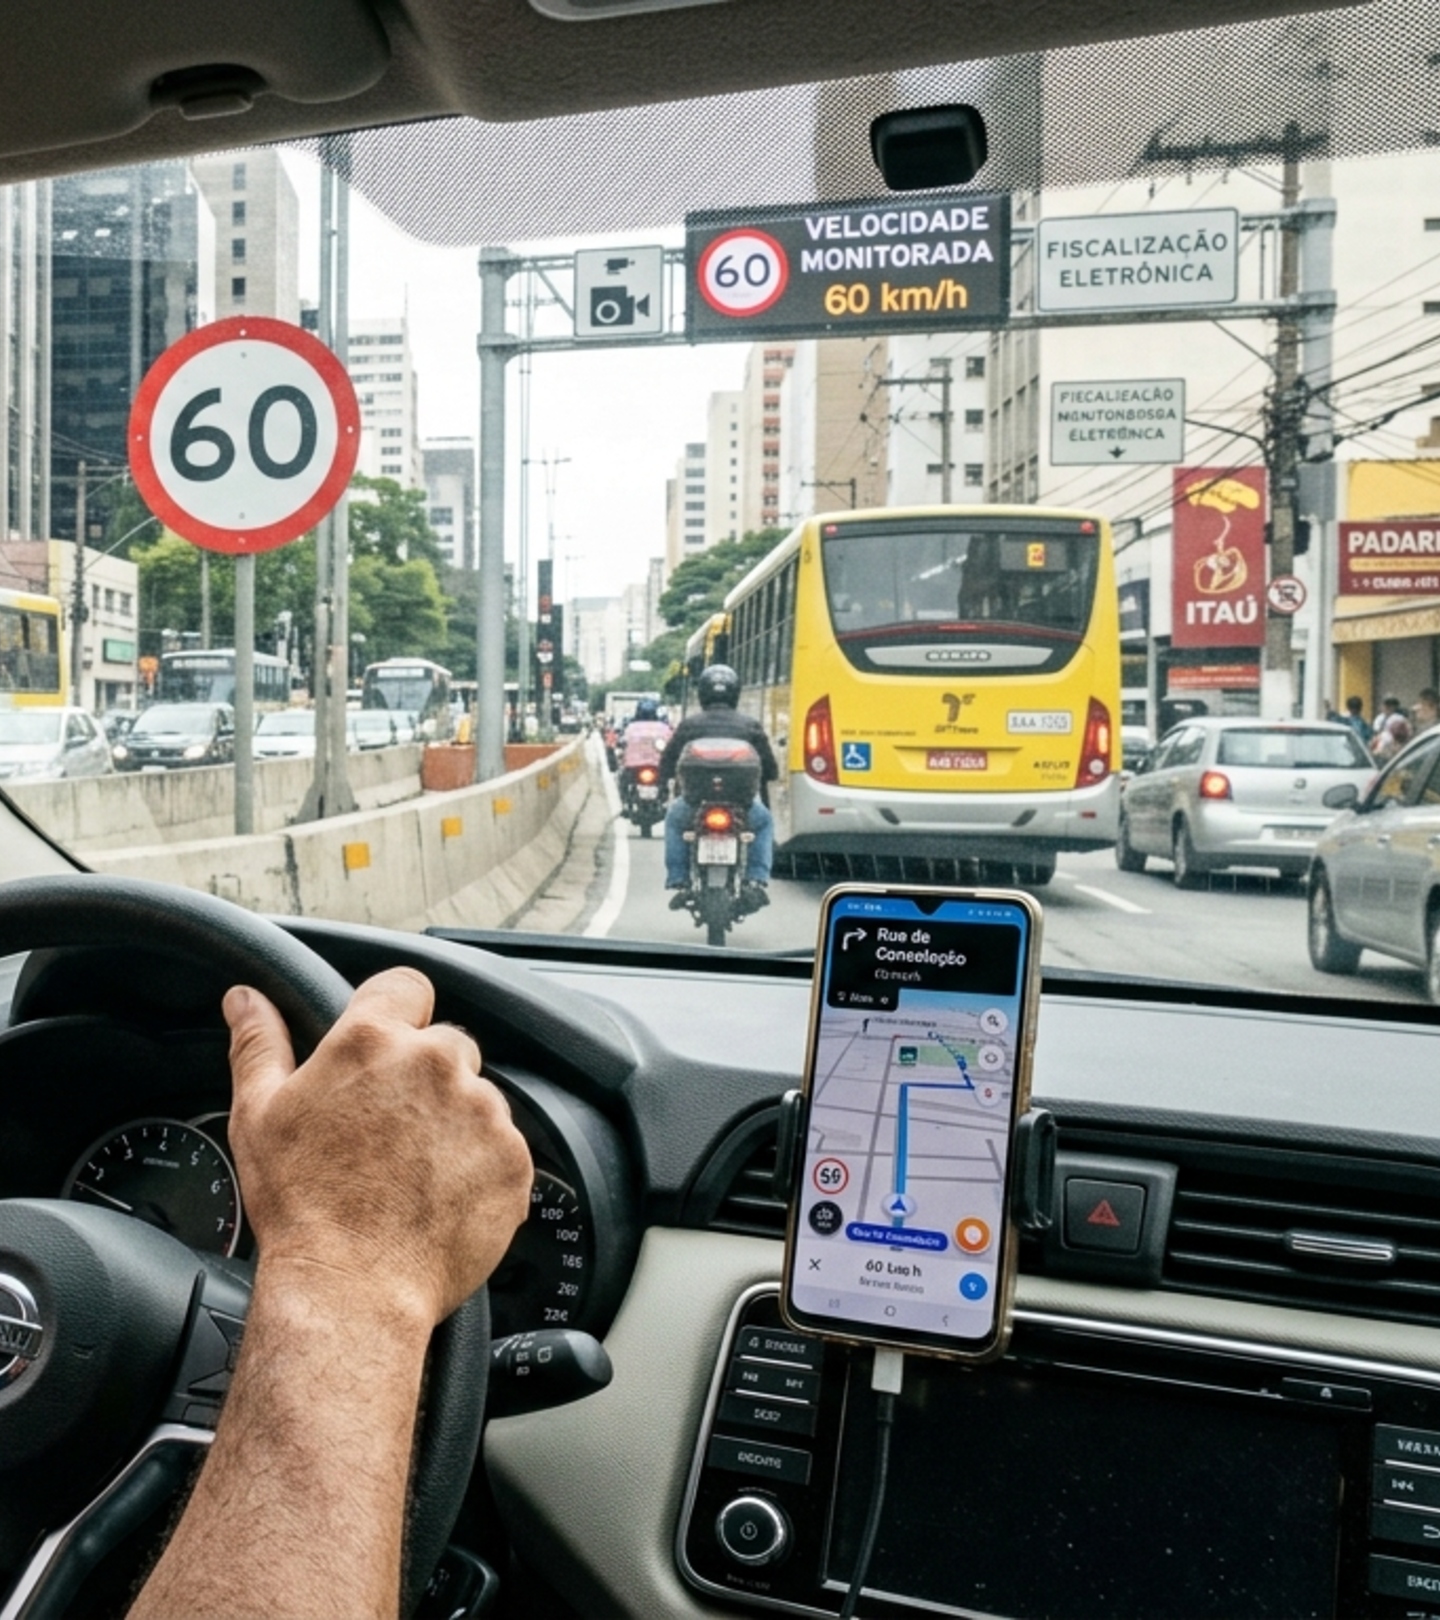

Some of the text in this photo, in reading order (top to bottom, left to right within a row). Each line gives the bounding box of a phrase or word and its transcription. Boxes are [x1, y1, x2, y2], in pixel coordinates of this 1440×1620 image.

[804, 206, 990, 241] VELOCIDADE
[800, 239, 994, 273] MONITORADA
[1047, 227, 1228, 260] FISCALIZAÇÃO
[714, 252, 771, 289] 60
[824, 278, 968, 316] 60 km/h
[169, 383, 318, 483] 60
[1186, 594, 1258, 625] ITAÚ
[910, 928, 931, 944] de
